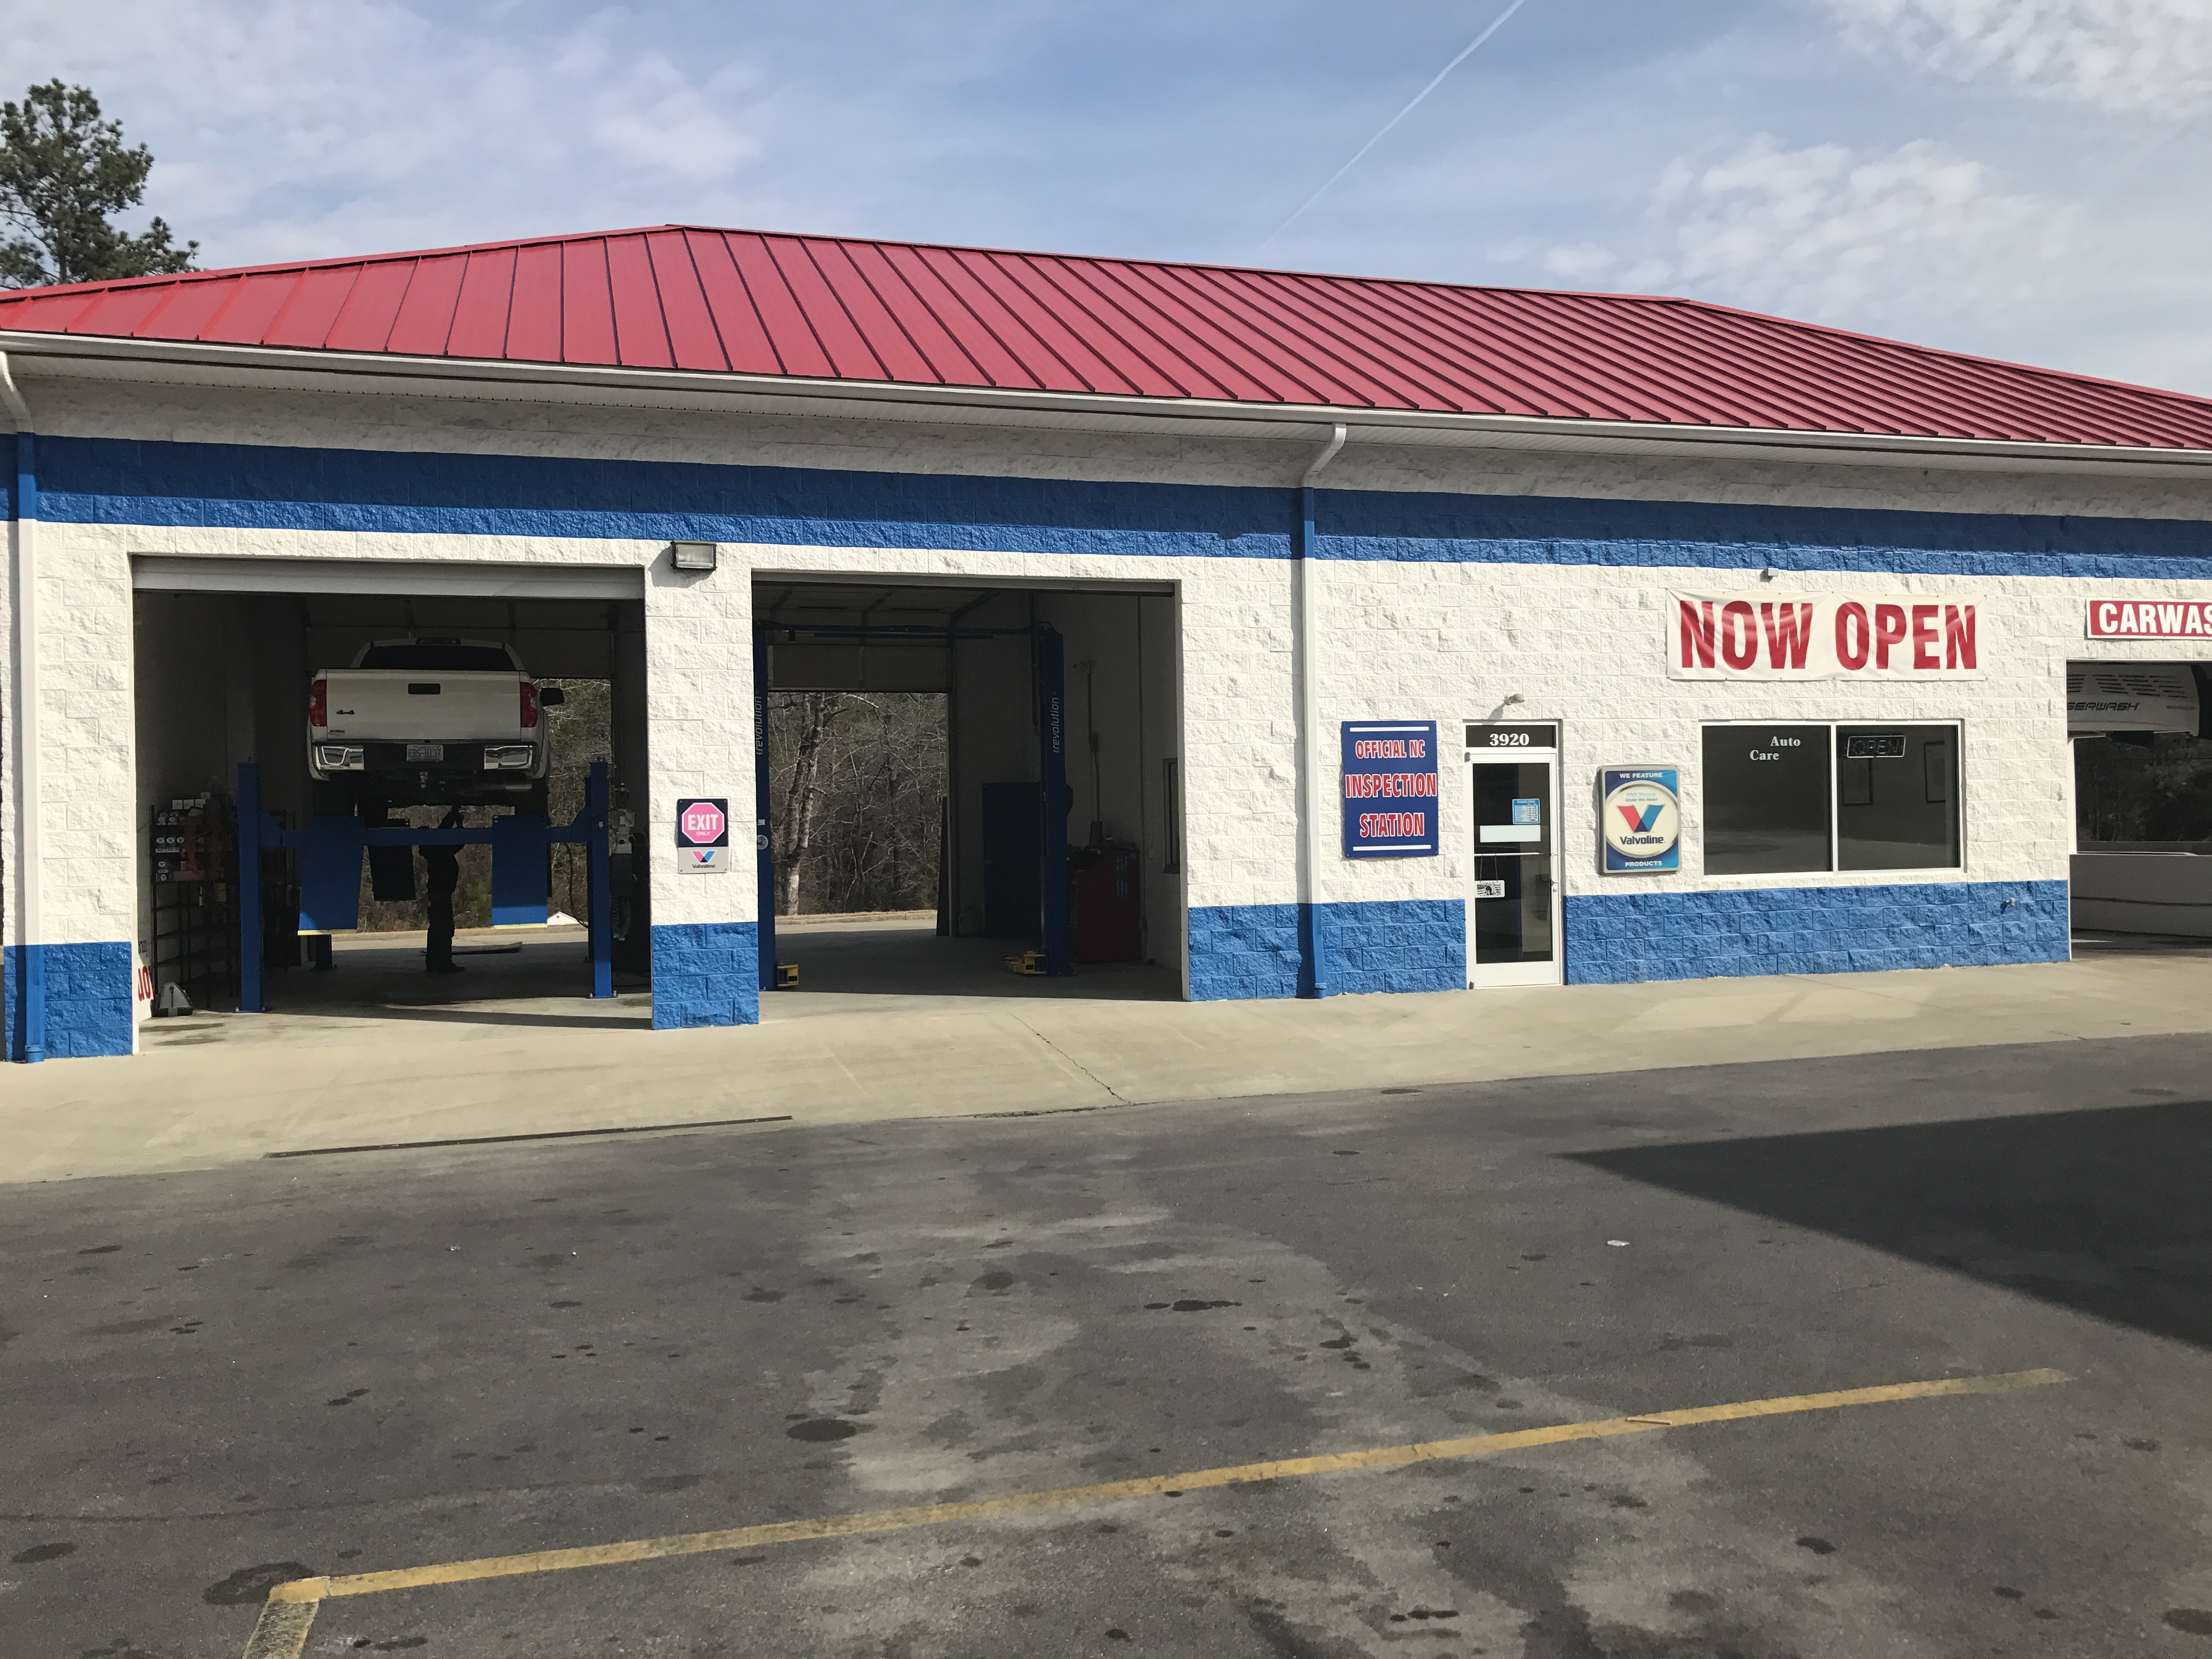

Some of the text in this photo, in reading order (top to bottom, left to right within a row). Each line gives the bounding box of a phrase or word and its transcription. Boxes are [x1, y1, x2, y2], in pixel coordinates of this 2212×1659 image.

[1680, 600, 1977, 671] NOW OPEN
[1051, 697, 1060, 749] revolution
[1489, 733, 1530, 746] 3920
[1770, 736, 1801, 747] Auto
[1356, 740, 1426, 759] OFFICIAL NC
[1750, 749, 1780, 760] Care
[1345, 772, 1437, 798] INSPECTION
[688, 814, 719, 831] EXIT
[1359, 812, 1424, 838] STATION
[1620, 835, 1664, 845] Valvoline
